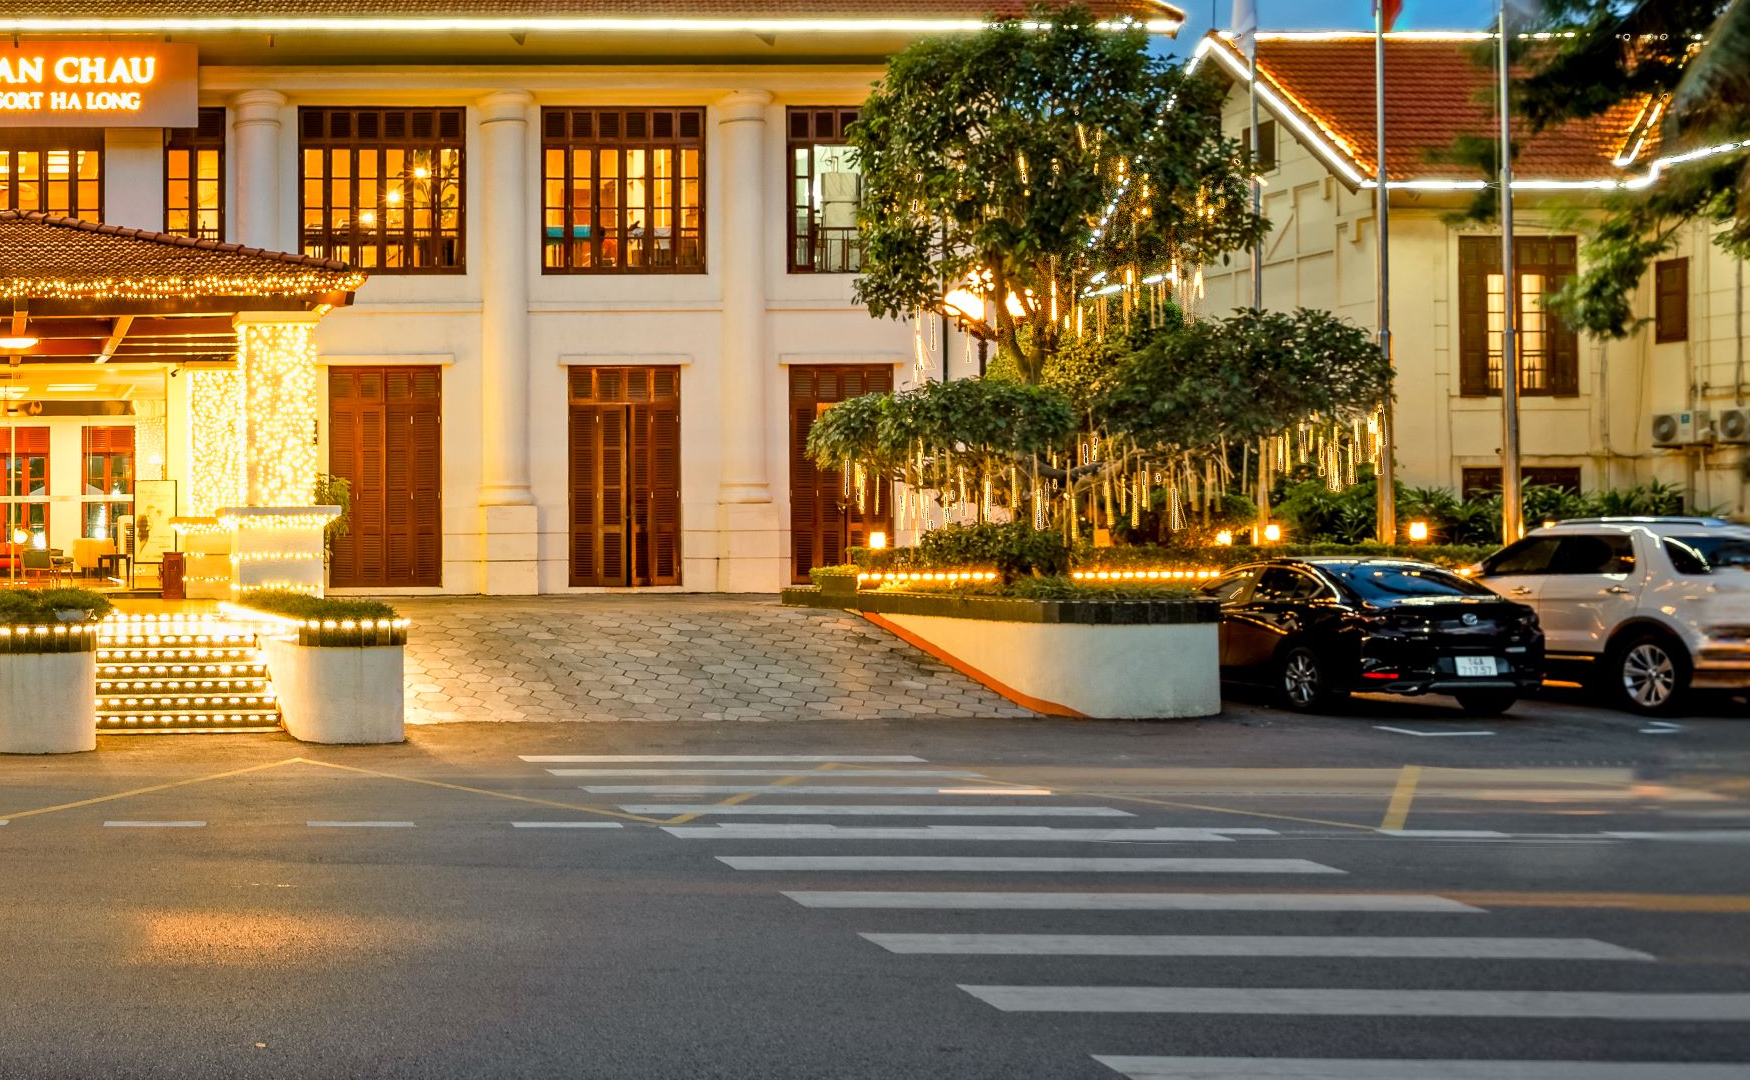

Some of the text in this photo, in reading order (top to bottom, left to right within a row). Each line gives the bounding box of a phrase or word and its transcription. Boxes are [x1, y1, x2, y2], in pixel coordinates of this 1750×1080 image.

[54, 56, 156, 84] CHAU
[50, 91, 81, 110] HA
[86, 91, 141, 110] LONG
